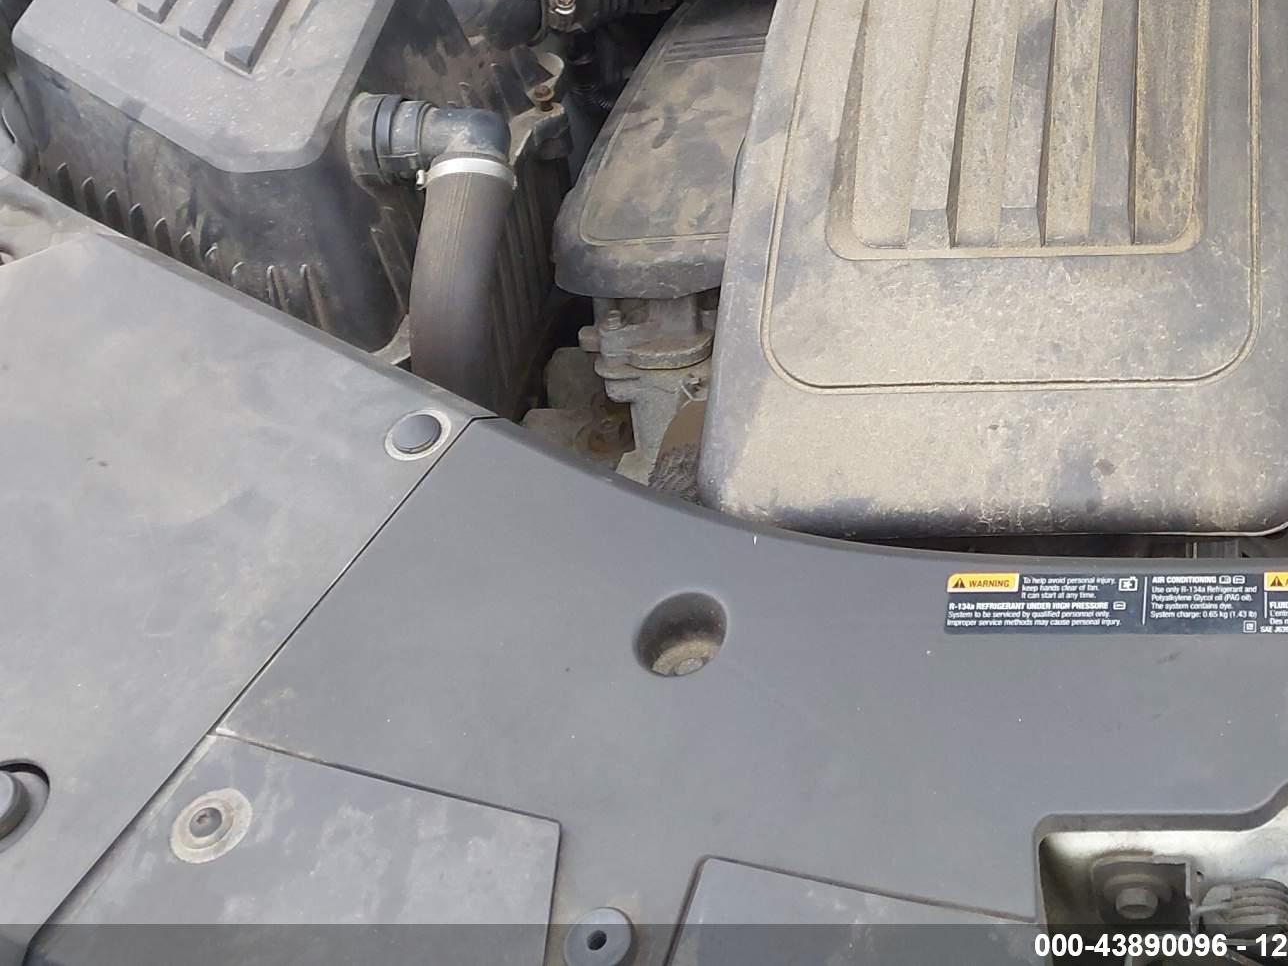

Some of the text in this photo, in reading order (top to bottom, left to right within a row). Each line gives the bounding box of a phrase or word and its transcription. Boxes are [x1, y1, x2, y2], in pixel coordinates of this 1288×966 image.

[969, 580, 1010, 588] WARNING
[1166, 586, 1180, 594] only
[1207, 586, 1243, 594] Refrigerant
[976, 602, 1025, 610] REFRIGERANT
[1026, 602, 1050, 610] UNDER
[1052, 602, 1070, 610] HIGH
[1072, 602, 1108, 610] PRESSURE
[1219, 602, 1233, 610] dye.
